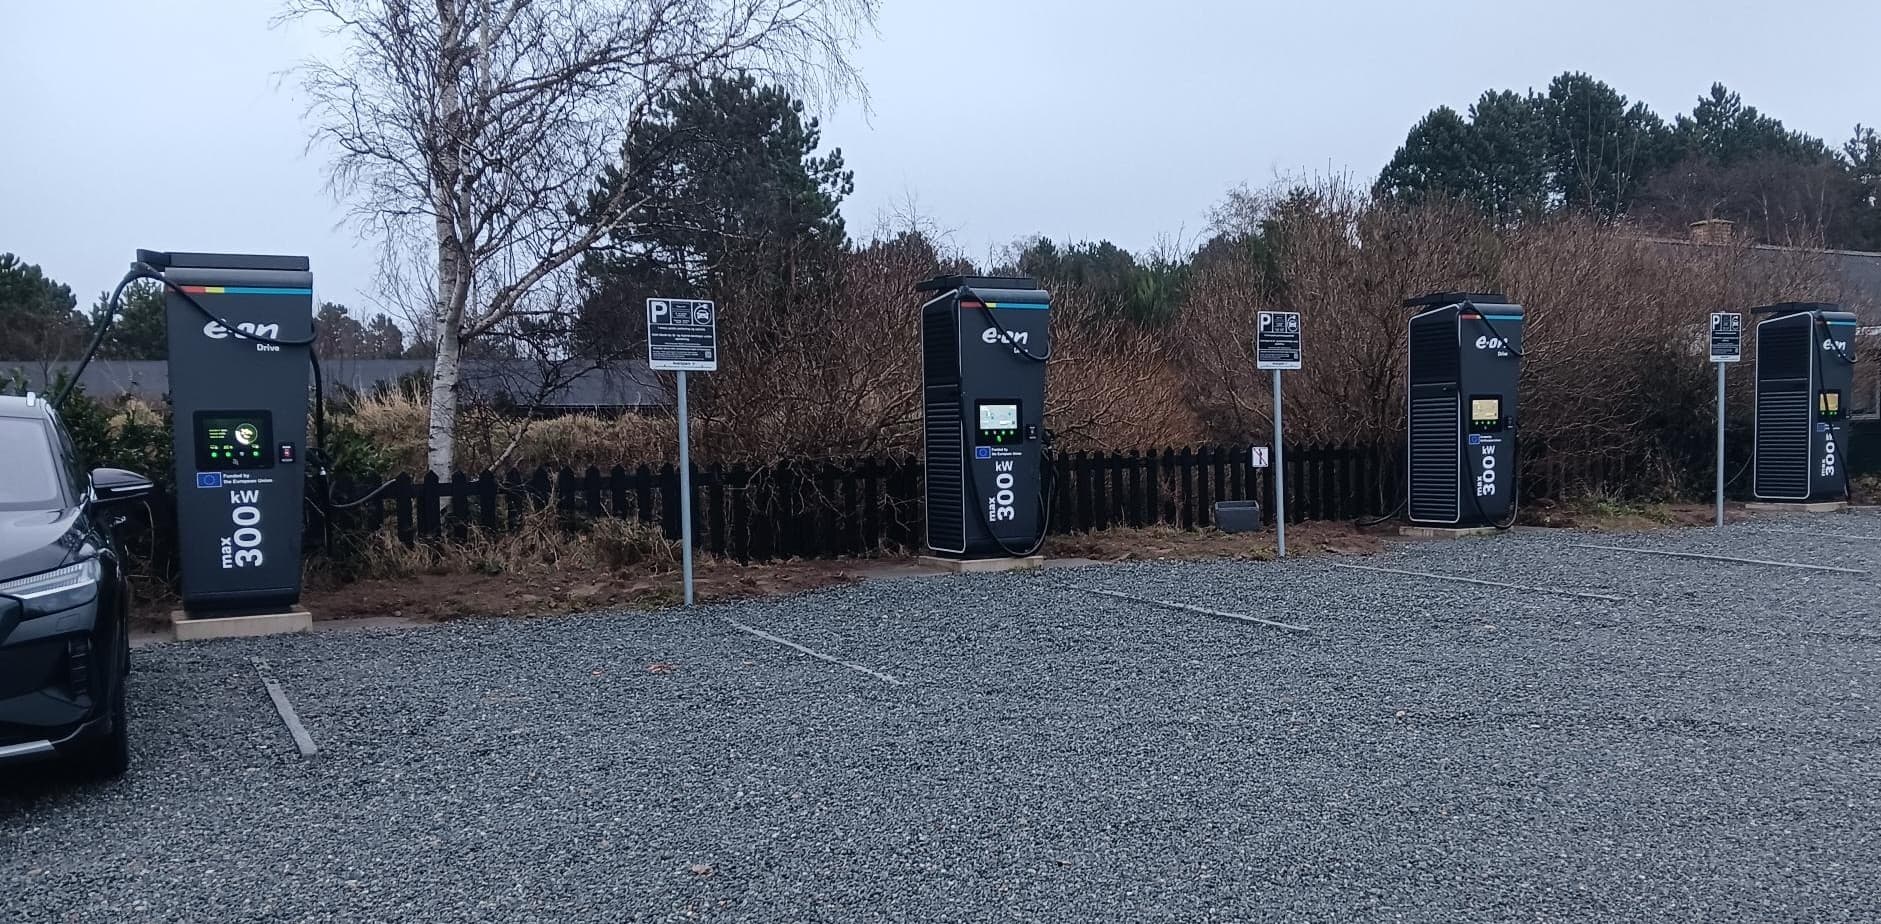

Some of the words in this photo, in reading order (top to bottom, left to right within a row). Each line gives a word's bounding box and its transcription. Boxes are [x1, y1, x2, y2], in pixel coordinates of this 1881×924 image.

[651, 301, 667, 322] P
[1260, 314, 1271, 331] P
[1713, 315, 1720, 329] P
[256, 343, 280, 352] Drive
[995, 460, 1014, 472] kW
[1825, 441, 1835, 476] 300
[1482, 455, 1496, 496] 300
[230, 489, 260, 504] kW
[996, 473, 1015, 521] 300
[988, 497, 996, 522] max
[232, 505, 263, 567] 300
[220, 536, 233, 569] max
